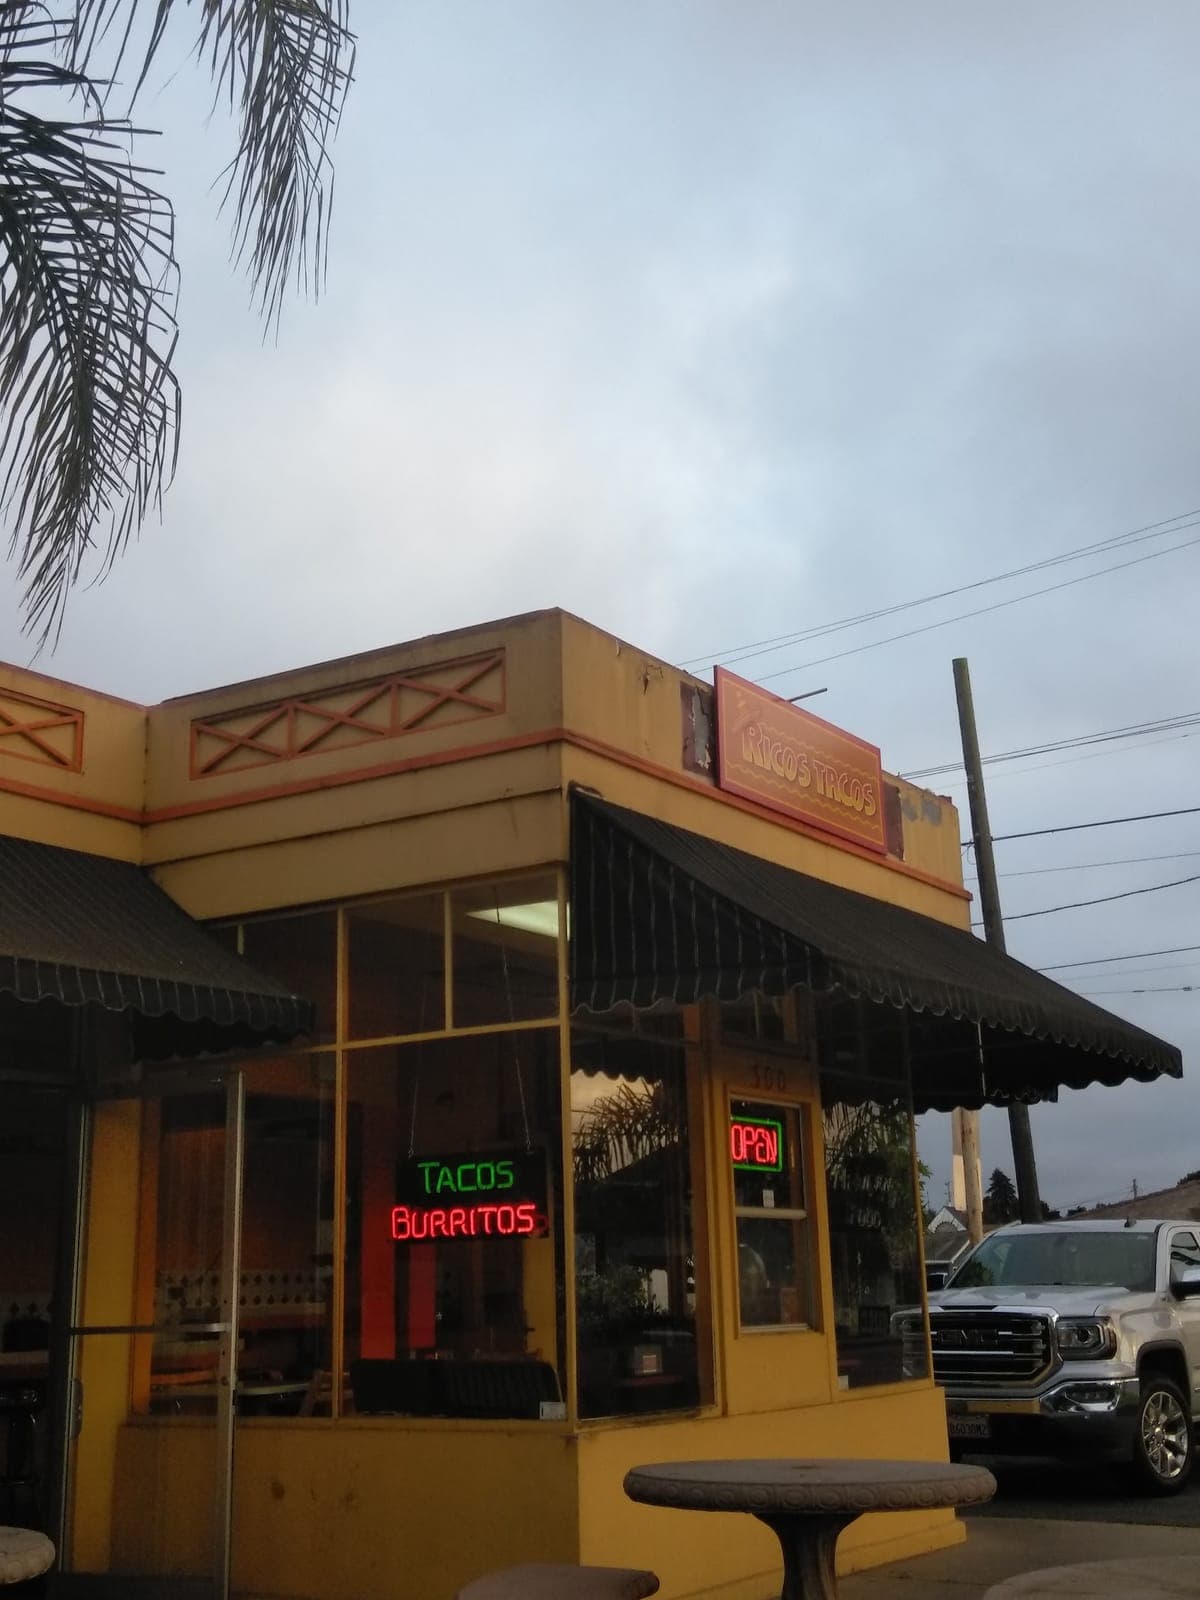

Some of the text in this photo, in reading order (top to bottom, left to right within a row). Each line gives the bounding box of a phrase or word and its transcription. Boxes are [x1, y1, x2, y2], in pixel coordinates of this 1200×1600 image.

[742, 724, 876, 816] RICOS TACOS
[731, 1124, 777, 1165] OPEN
[417, 1161, 514, 1194] TACOS
[391, 1204, 537, 1239] BURRITOS
